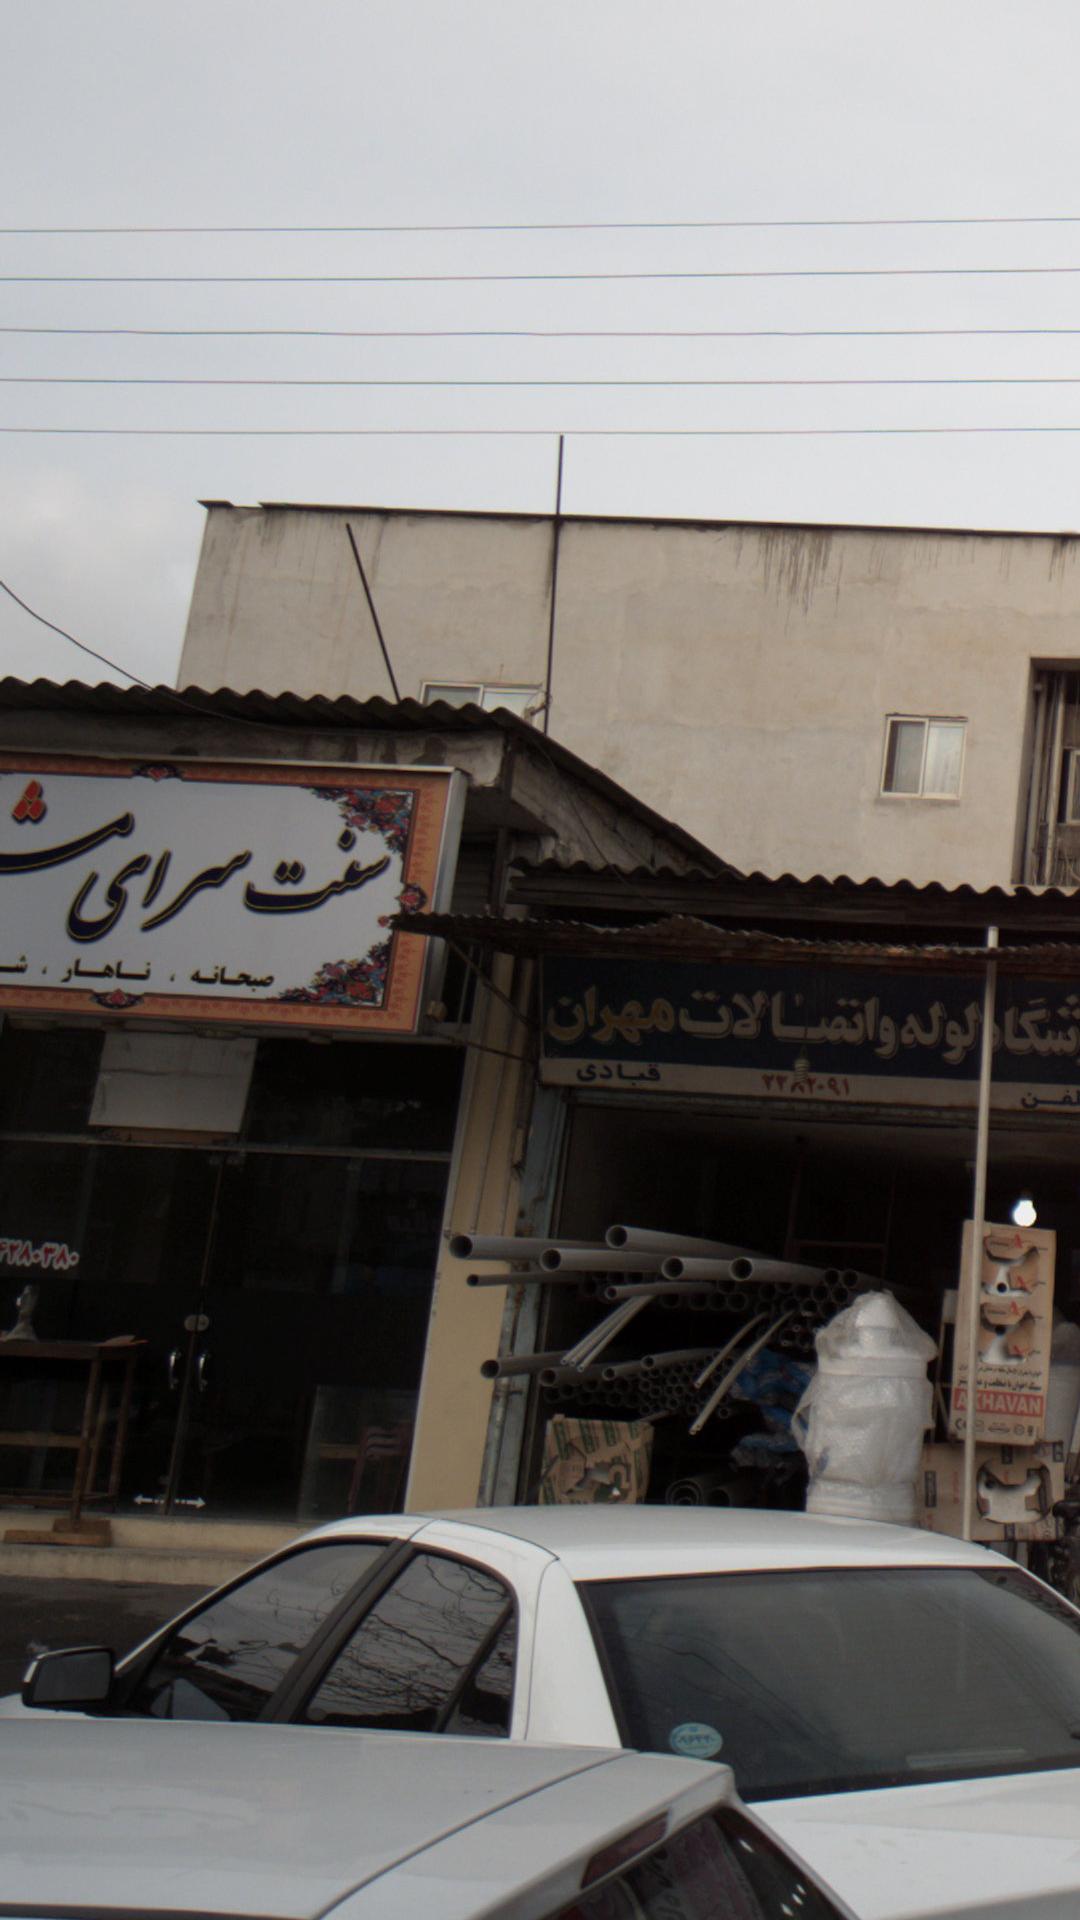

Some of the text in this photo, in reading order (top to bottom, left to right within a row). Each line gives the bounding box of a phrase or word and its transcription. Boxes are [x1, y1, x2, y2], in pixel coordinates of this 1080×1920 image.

[67, 827, 390, 943] سنت سرای
[61, 958, 151, 983] ناهار
[190, 965, 275, 992] صبحانه
[545, 984, 675, 1045] مهران
[901, 1000, 985, 1064] لوله
[576, 1063, 660, 1086] قبادی
